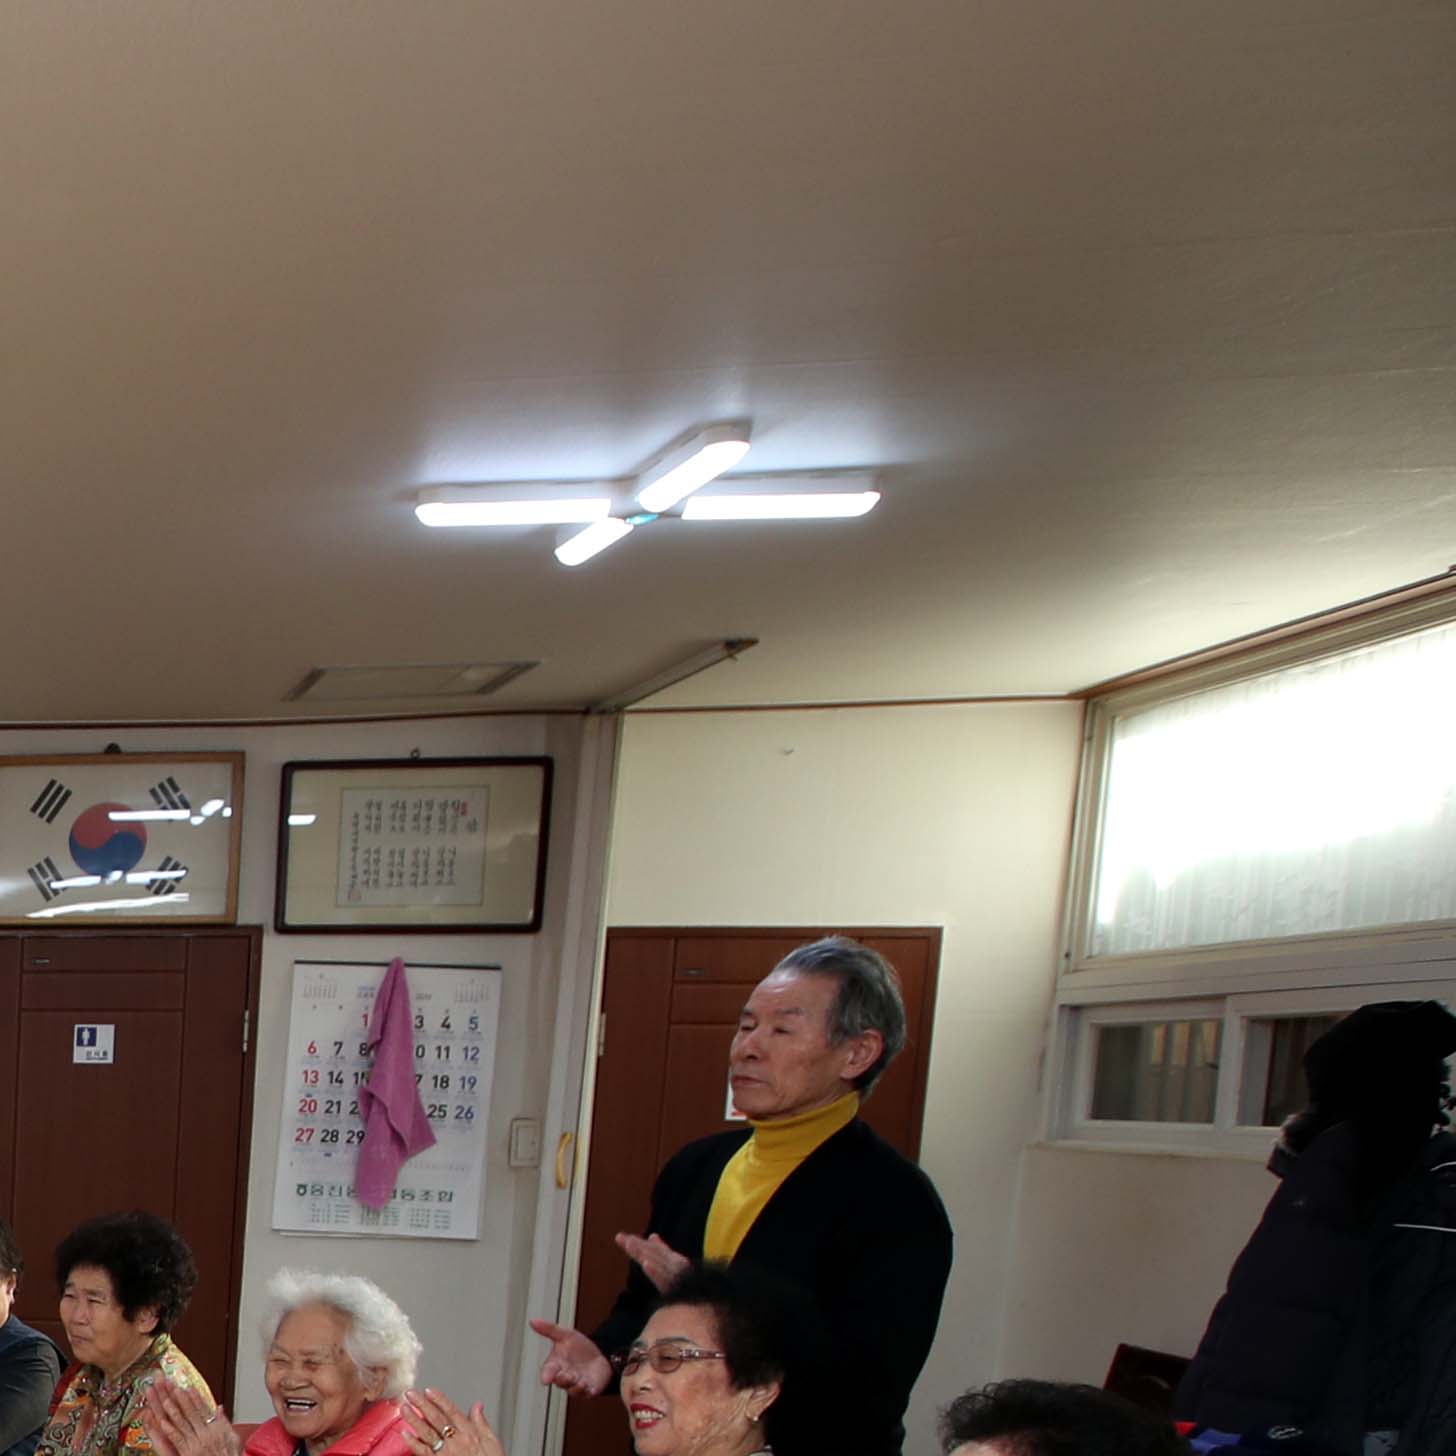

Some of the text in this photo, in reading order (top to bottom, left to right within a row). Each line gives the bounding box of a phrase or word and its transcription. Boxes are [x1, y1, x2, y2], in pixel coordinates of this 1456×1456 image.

[362, 1014, 478, 1032] 1 3 4 5
[308, 1041, 317, 1056] 6
[334, 1042, 343, 1058] 7
[416, 1044, 425, 1059] 0
[436, 1045, 450, 1060] 11
[463, 1046, 479, 1063] 12
[304, 1070, 319, 1086] 13
[329, 1071, 343, 1086] 14
[433, 1075, 449, 1091] 18
[461, 1076, 477, 1091] 19
[299, 1099, 474, 1122] 20 21 2 25 26
[295, 1128, 366, 1146] 27 28 29
